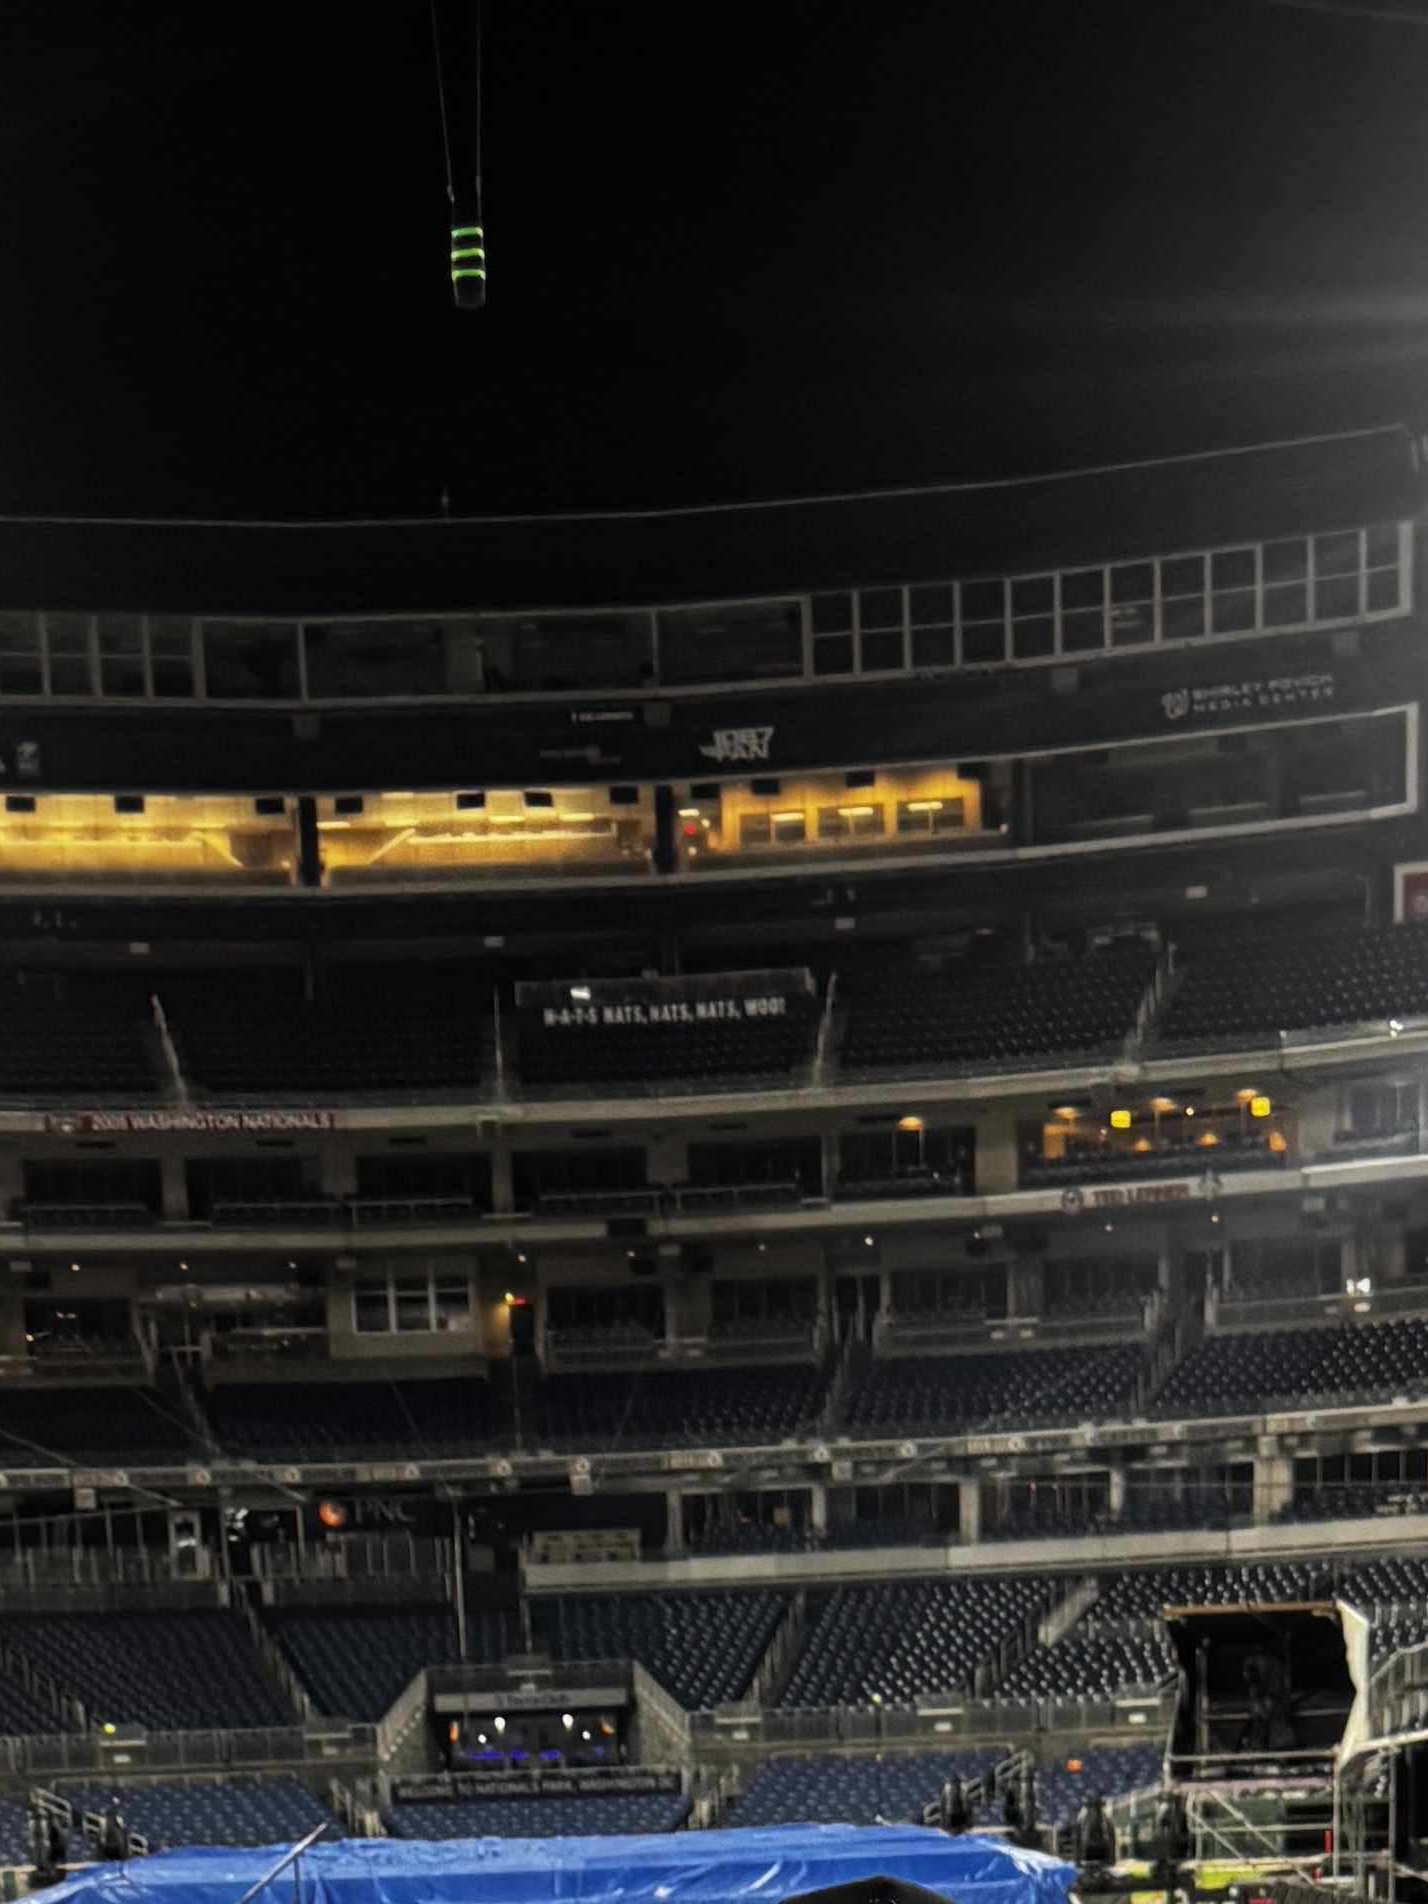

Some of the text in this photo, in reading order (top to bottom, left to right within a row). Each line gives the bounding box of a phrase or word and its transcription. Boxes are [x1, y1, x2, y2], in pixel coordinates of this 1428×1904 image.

[129, 1113, 240, 1130] WASHINGTON
[242, 1112, 331, 1130] NATIONALS
[355, 1498, 417, 1525] PNC
